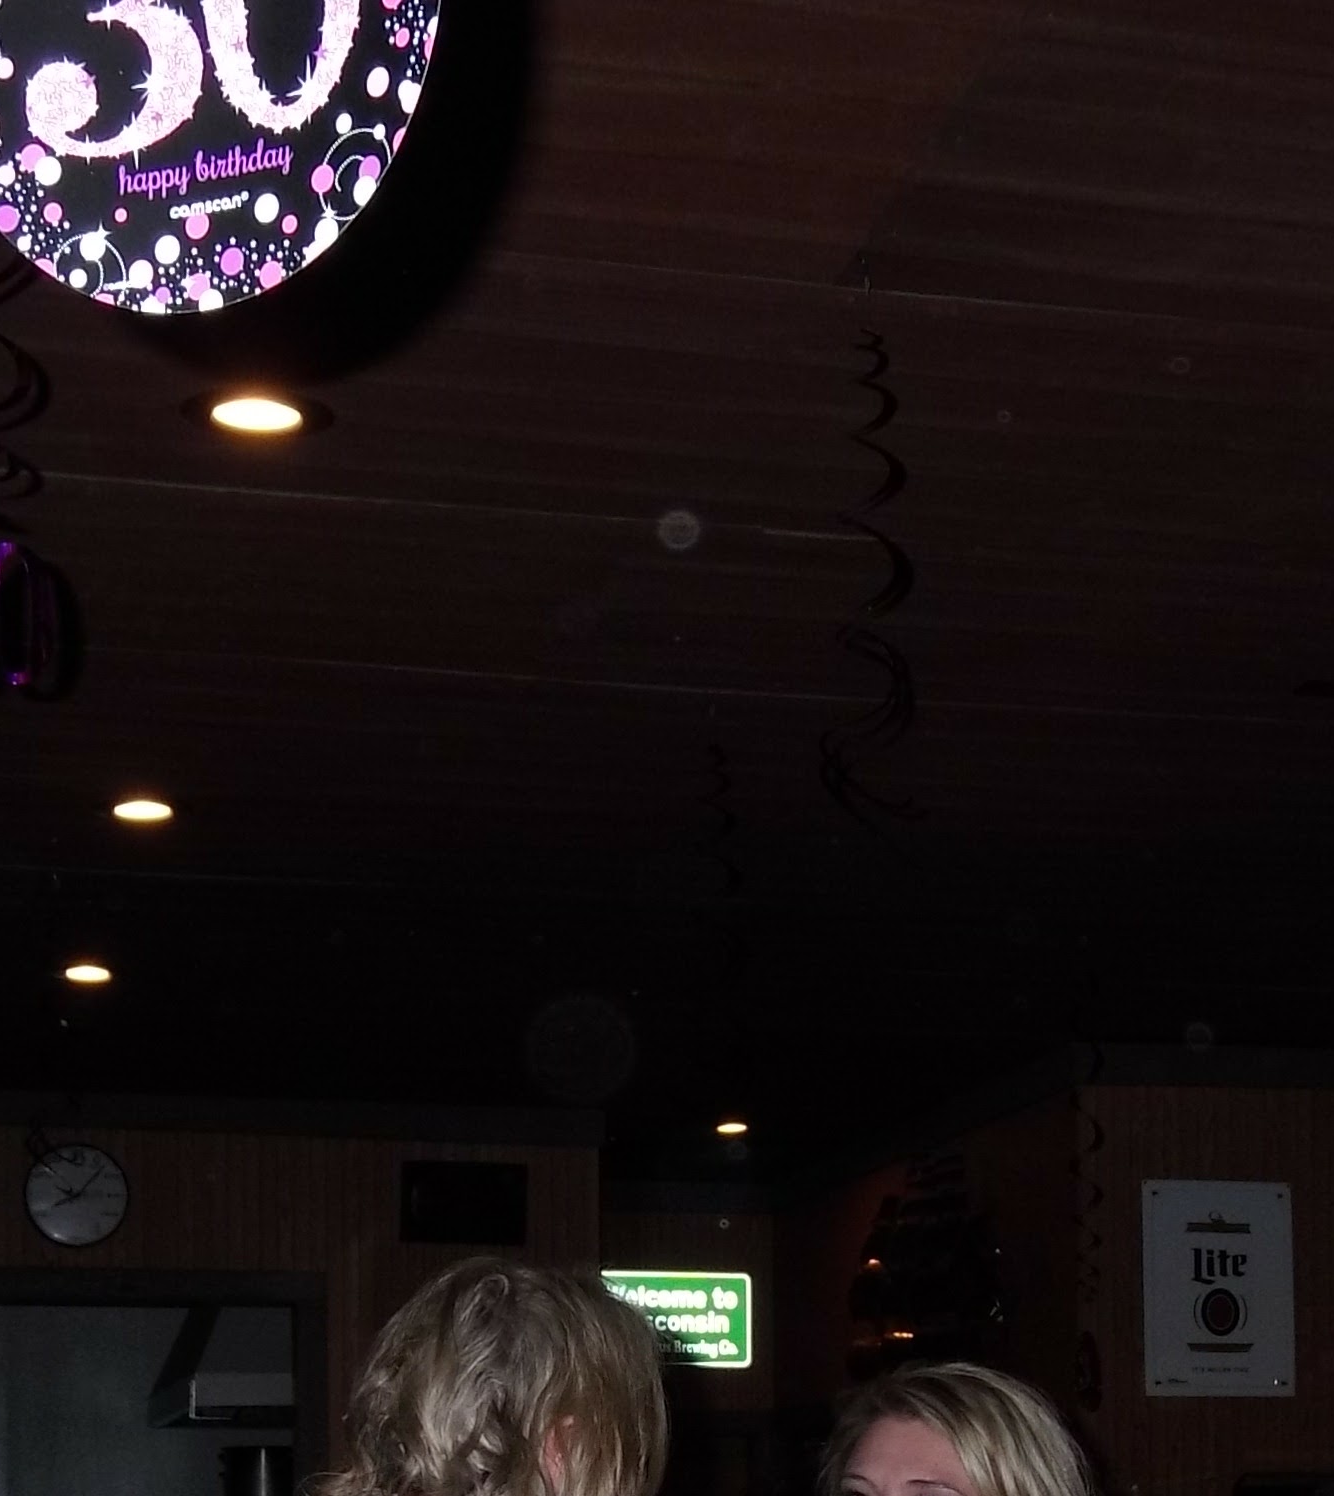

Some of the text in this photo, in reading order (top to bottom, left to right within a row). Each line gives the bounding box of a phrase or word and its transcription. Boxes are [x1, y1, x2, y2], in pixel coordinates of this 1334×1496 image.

[119, 138, 293, 200] happy birthday
[1191, 1248, 1247, 1285] Lite
[712, 1286, 739, 1310] to
[647, 1310, 731, 1334] consin
